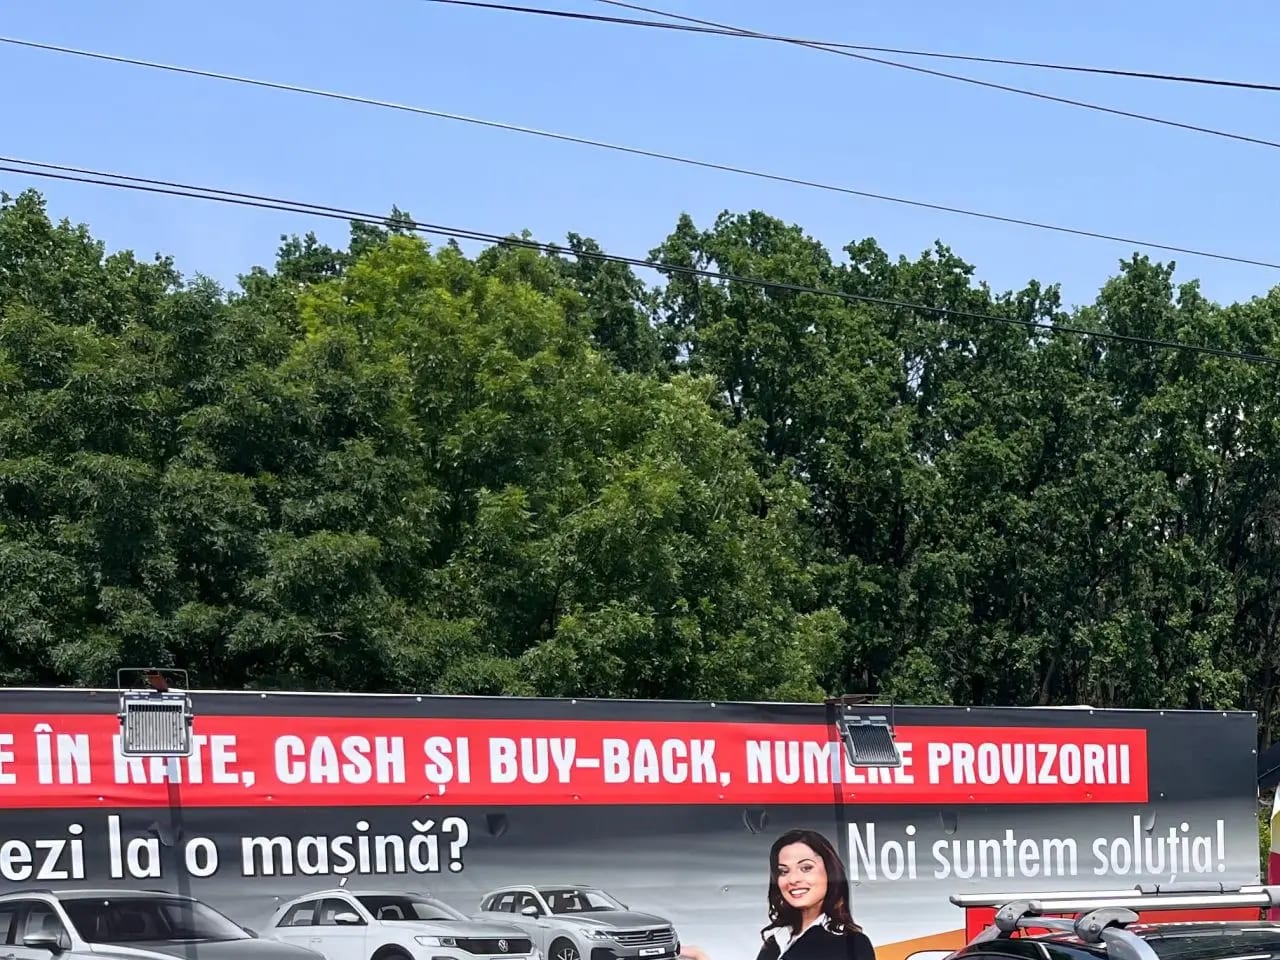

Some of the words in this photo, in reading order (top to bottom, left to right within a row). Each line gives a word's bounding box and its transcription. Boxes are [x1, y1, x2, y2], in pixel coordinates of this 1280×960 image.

[33, 723, 91, 784] ÎN
[274, 735, 406, 784] CASH
[929, 742, 1131, 785] PROVIZORII
[0, 824, 84, 881] ezi
[108, 815, 161, 879] la
[184, 836, 219, 877] o
[241, 817, 469, 886] mașină?
[847, 822, 918, 881] Noi
[933, 829, 1078, 879] suntem
[1093, 815, 1226, 884] soluția!
